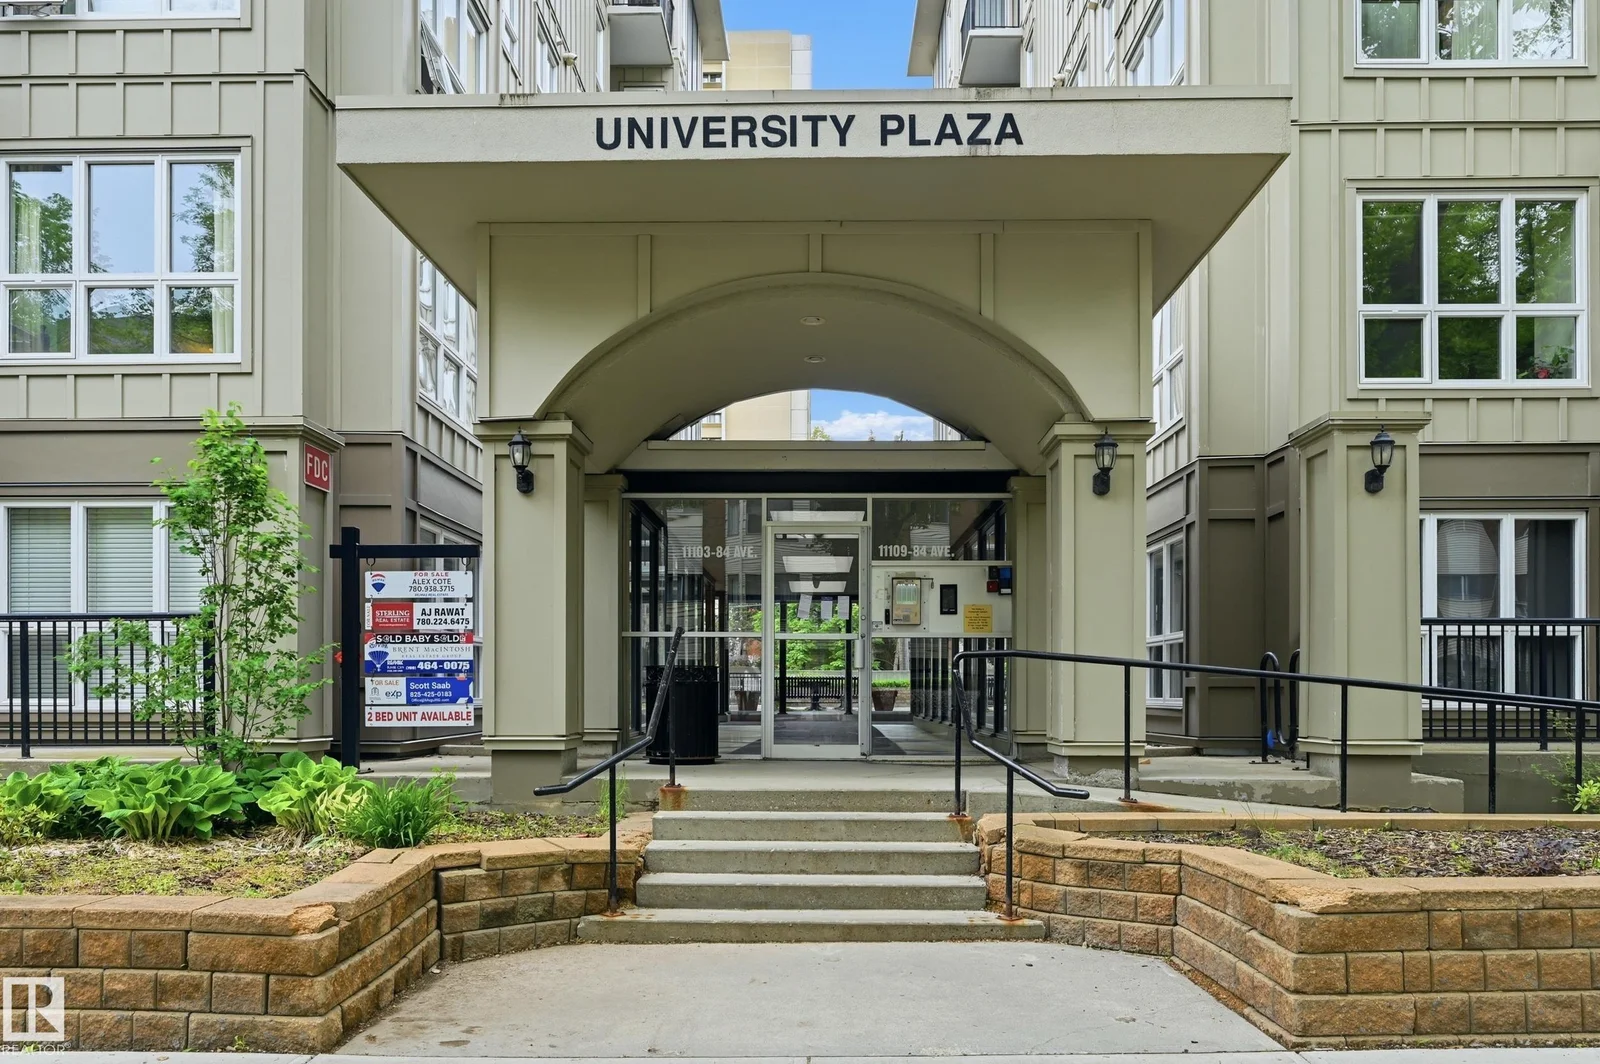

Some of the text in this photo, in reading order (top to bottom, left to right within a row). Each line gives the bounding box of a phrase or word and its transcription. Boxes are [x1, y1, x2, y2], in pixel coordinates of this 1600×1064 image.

[596, 113, 1023, 150] UNIVERSITY PLAZA
[306, 452, 328, 482] FDC
[682, 545, 757, 558] 11103-84 AVE.
[878, 544, 955, 557] 11109-84 AVE.
[408, 585, 455, 593] 780.938.3715
[375, 609, 410, 617] STERLING
[420, 607, 465, 617] AJ RAWAT
[416, 617, 470, 626] 780.224.6475
[404, 634, 431, 643] BABY
[392, 646, 419, 654] BRENT
[416, 661, 470, 670] 464-0075
[409, 682, 451, 690] Scott Saab
[367, 711, 472, 722] 2 BED UNIT AVAILABLE
